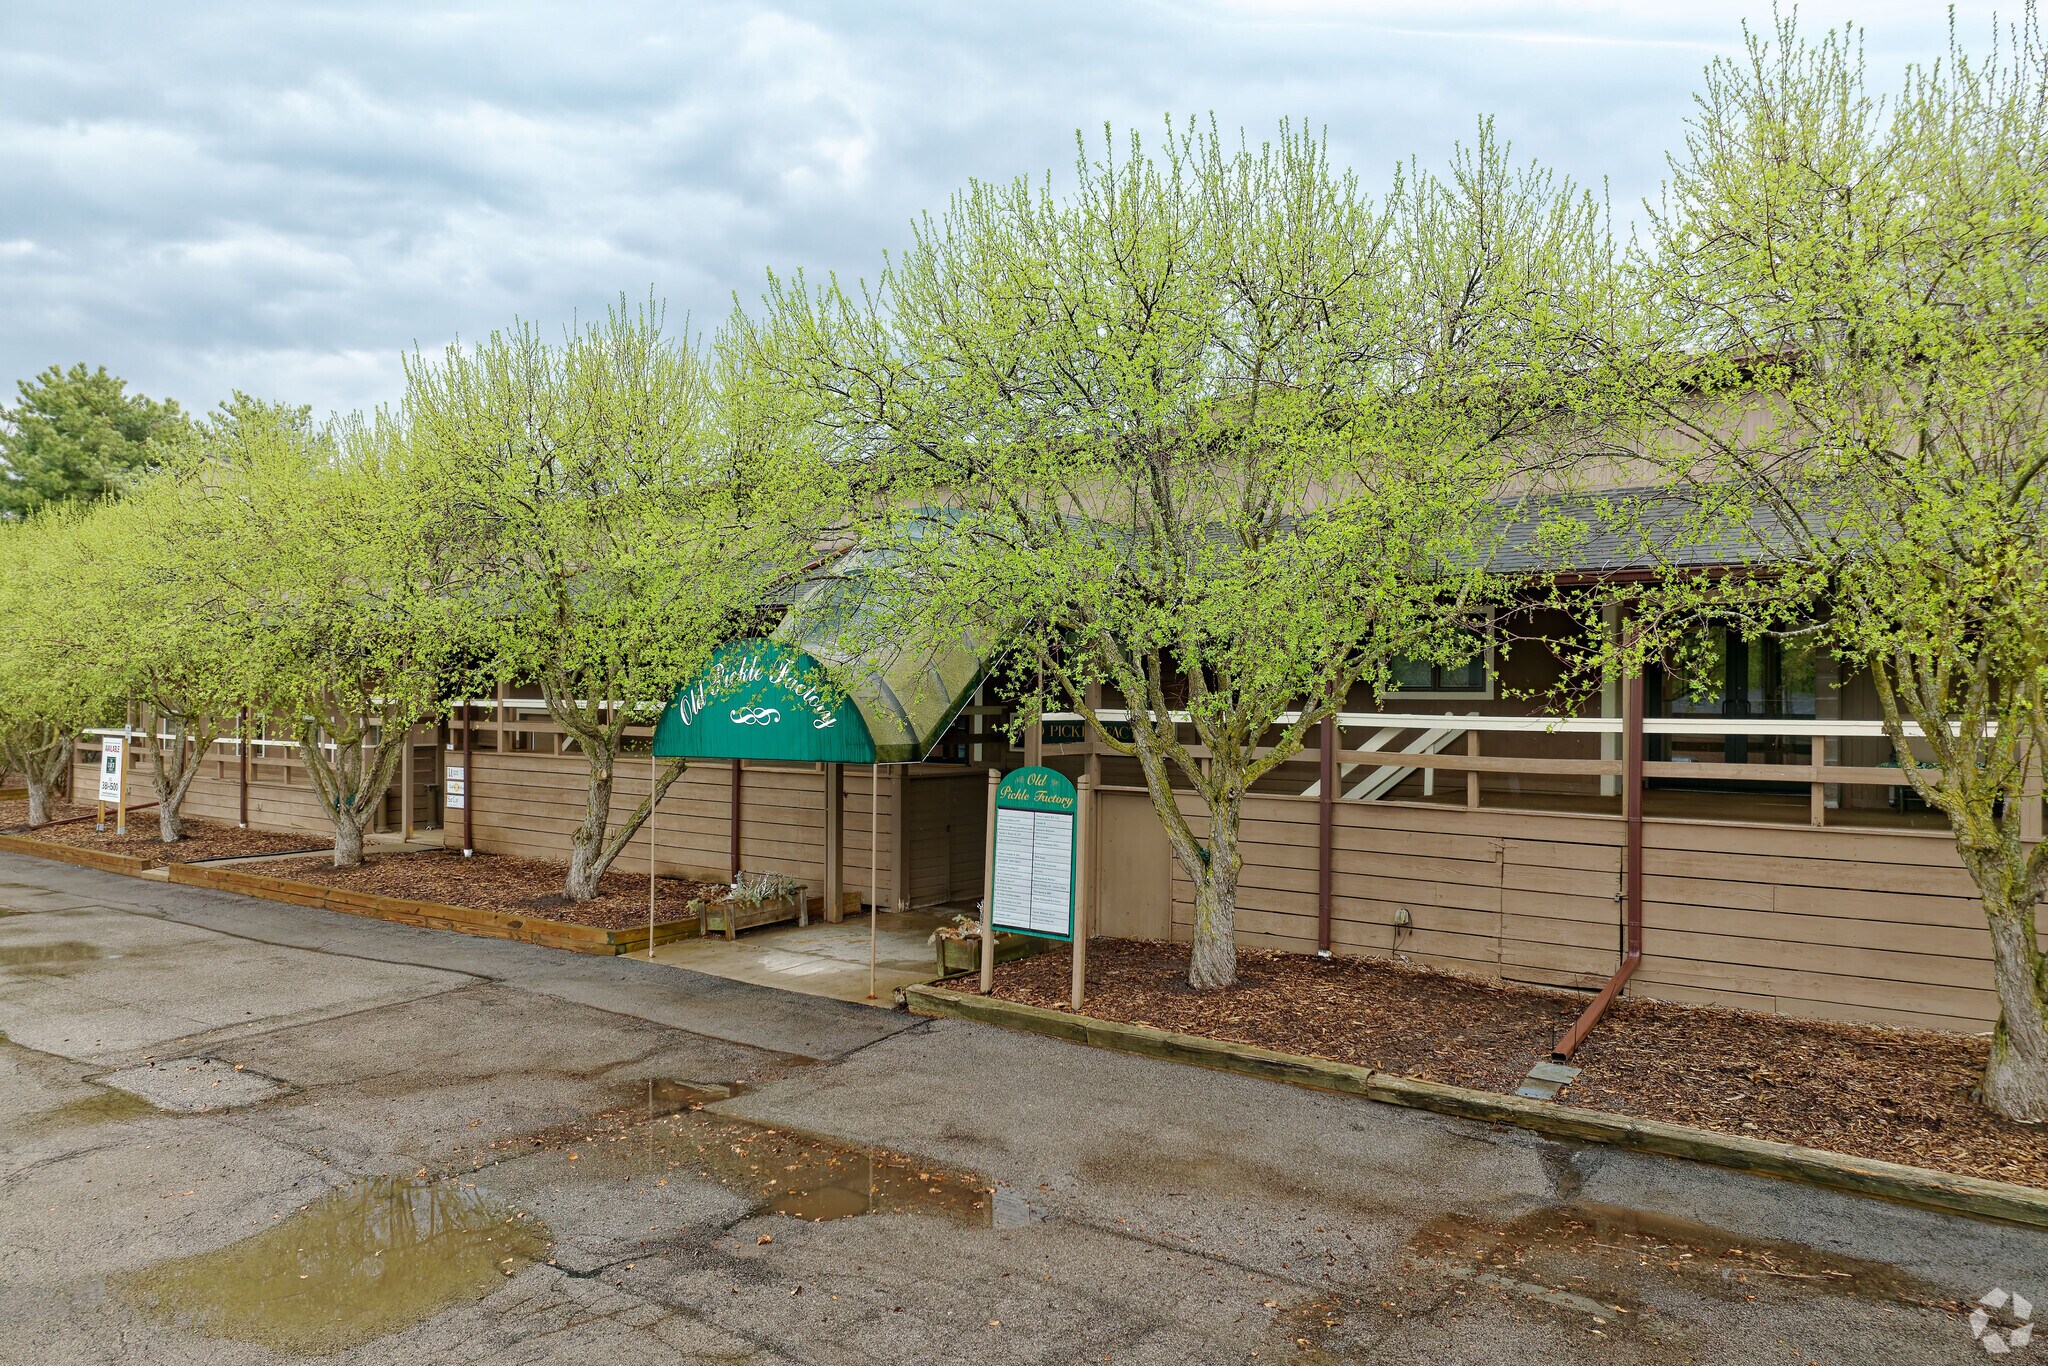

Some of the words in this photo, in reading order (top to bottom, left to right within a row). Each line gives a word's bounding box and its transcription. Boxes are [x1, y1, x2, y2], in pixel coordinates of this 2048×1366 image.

[680, 679, 706, 726] Old
[709, 656, 763, 696] Pickle
[769, 658, 838, 730] Factory
[1027, 773, 1048, 787] Old
[1000, 785, 1030, 801] Pickle
[1034, 790, 1074, 809] Factory
